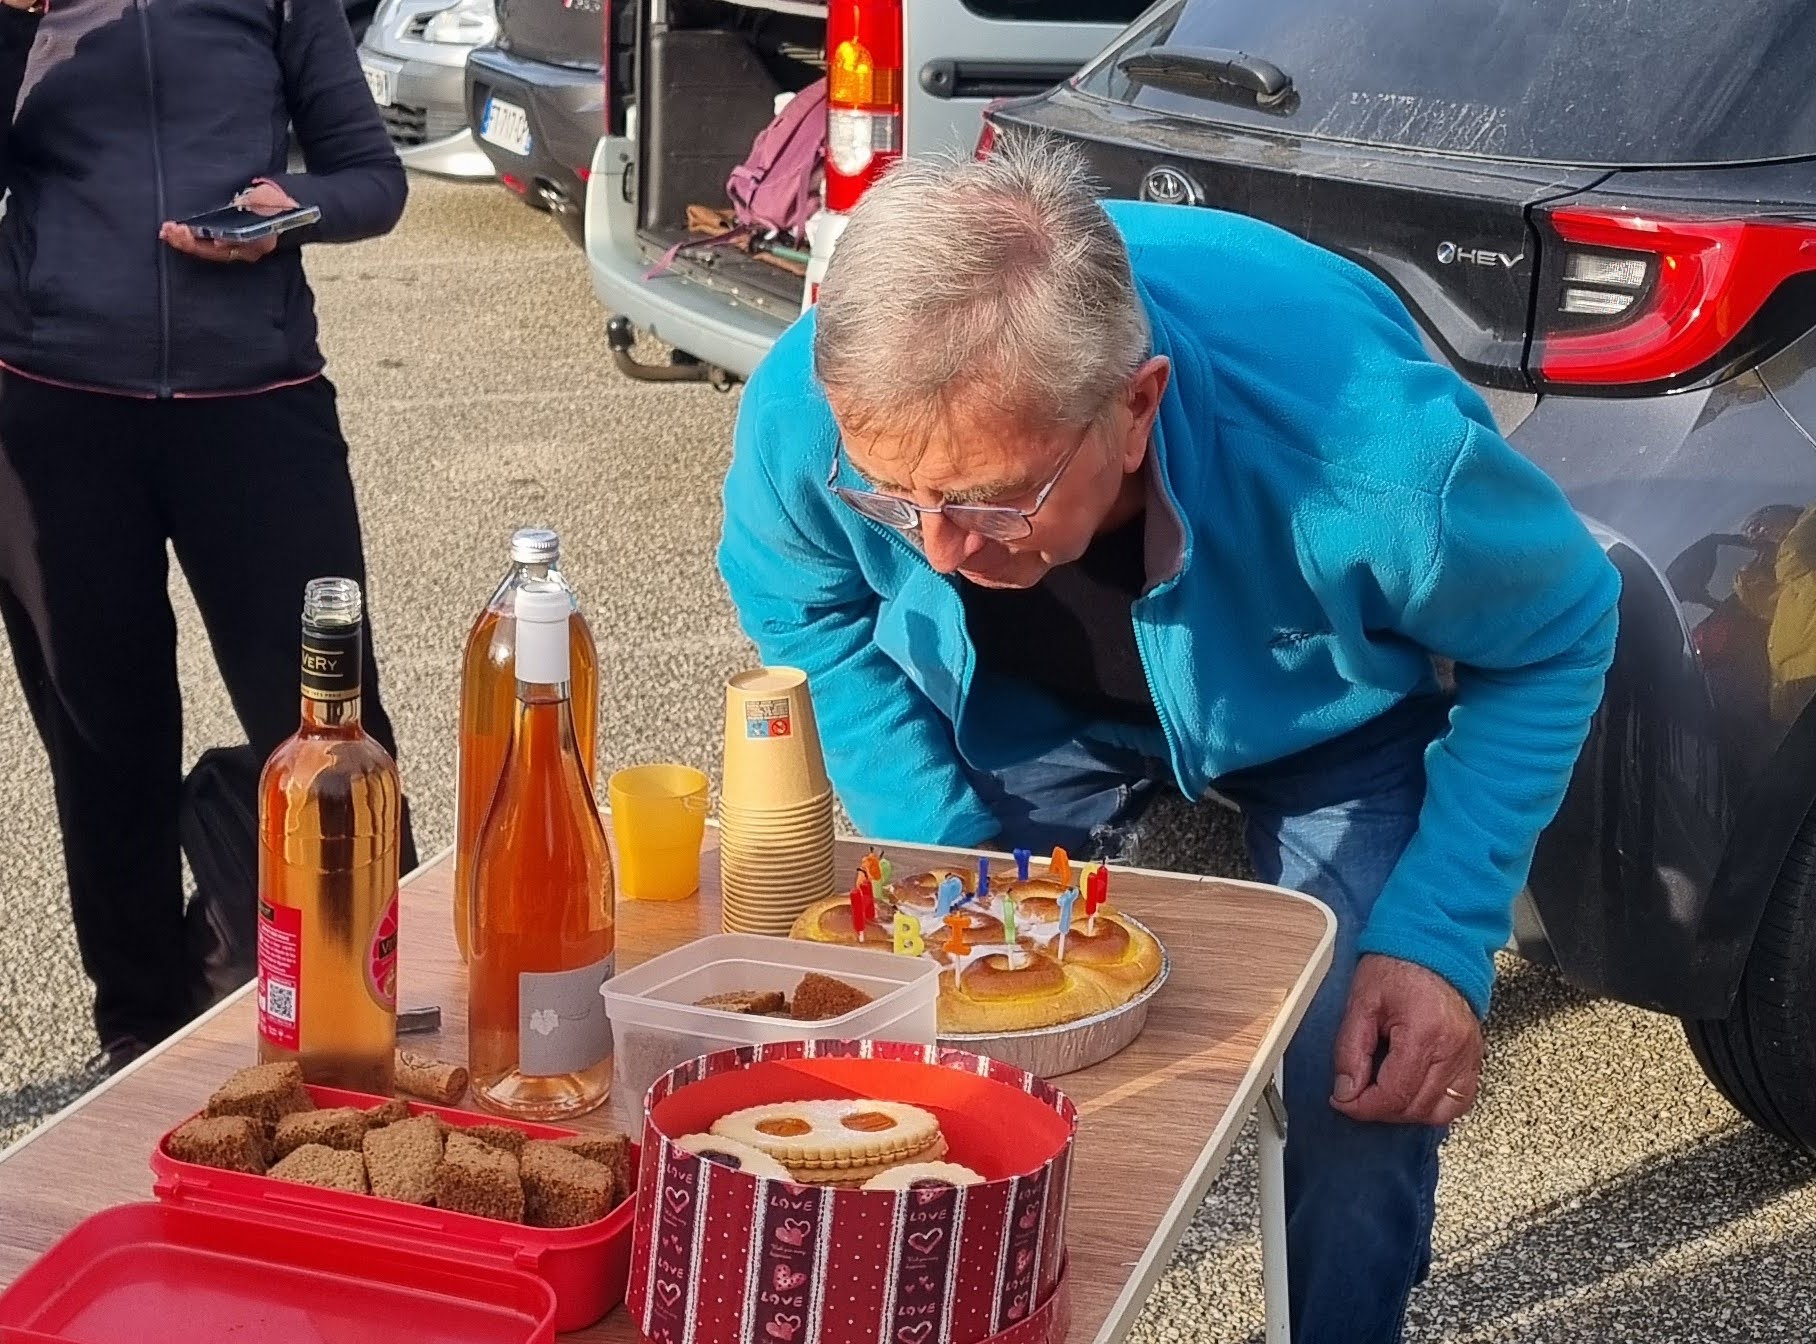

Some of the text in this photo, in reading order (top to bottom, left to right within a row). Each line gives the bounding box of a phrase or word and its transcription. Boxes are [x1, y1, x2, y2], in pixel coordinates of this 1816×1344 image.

[1457, 247, 1524, 267] HEV
[667, 1163, 693, 1184] LOVE
[770, 1195, 813, 1212] LOVE
[909, 1208, 947, 1222] LOVE
[657, 1257, 684, 1278] LOVE
[1005, 1271, 1031, 1292] LOVE
[760, 1291, 803, 1307] LOVE
[897, 1302, 936, 1316] LOVE
